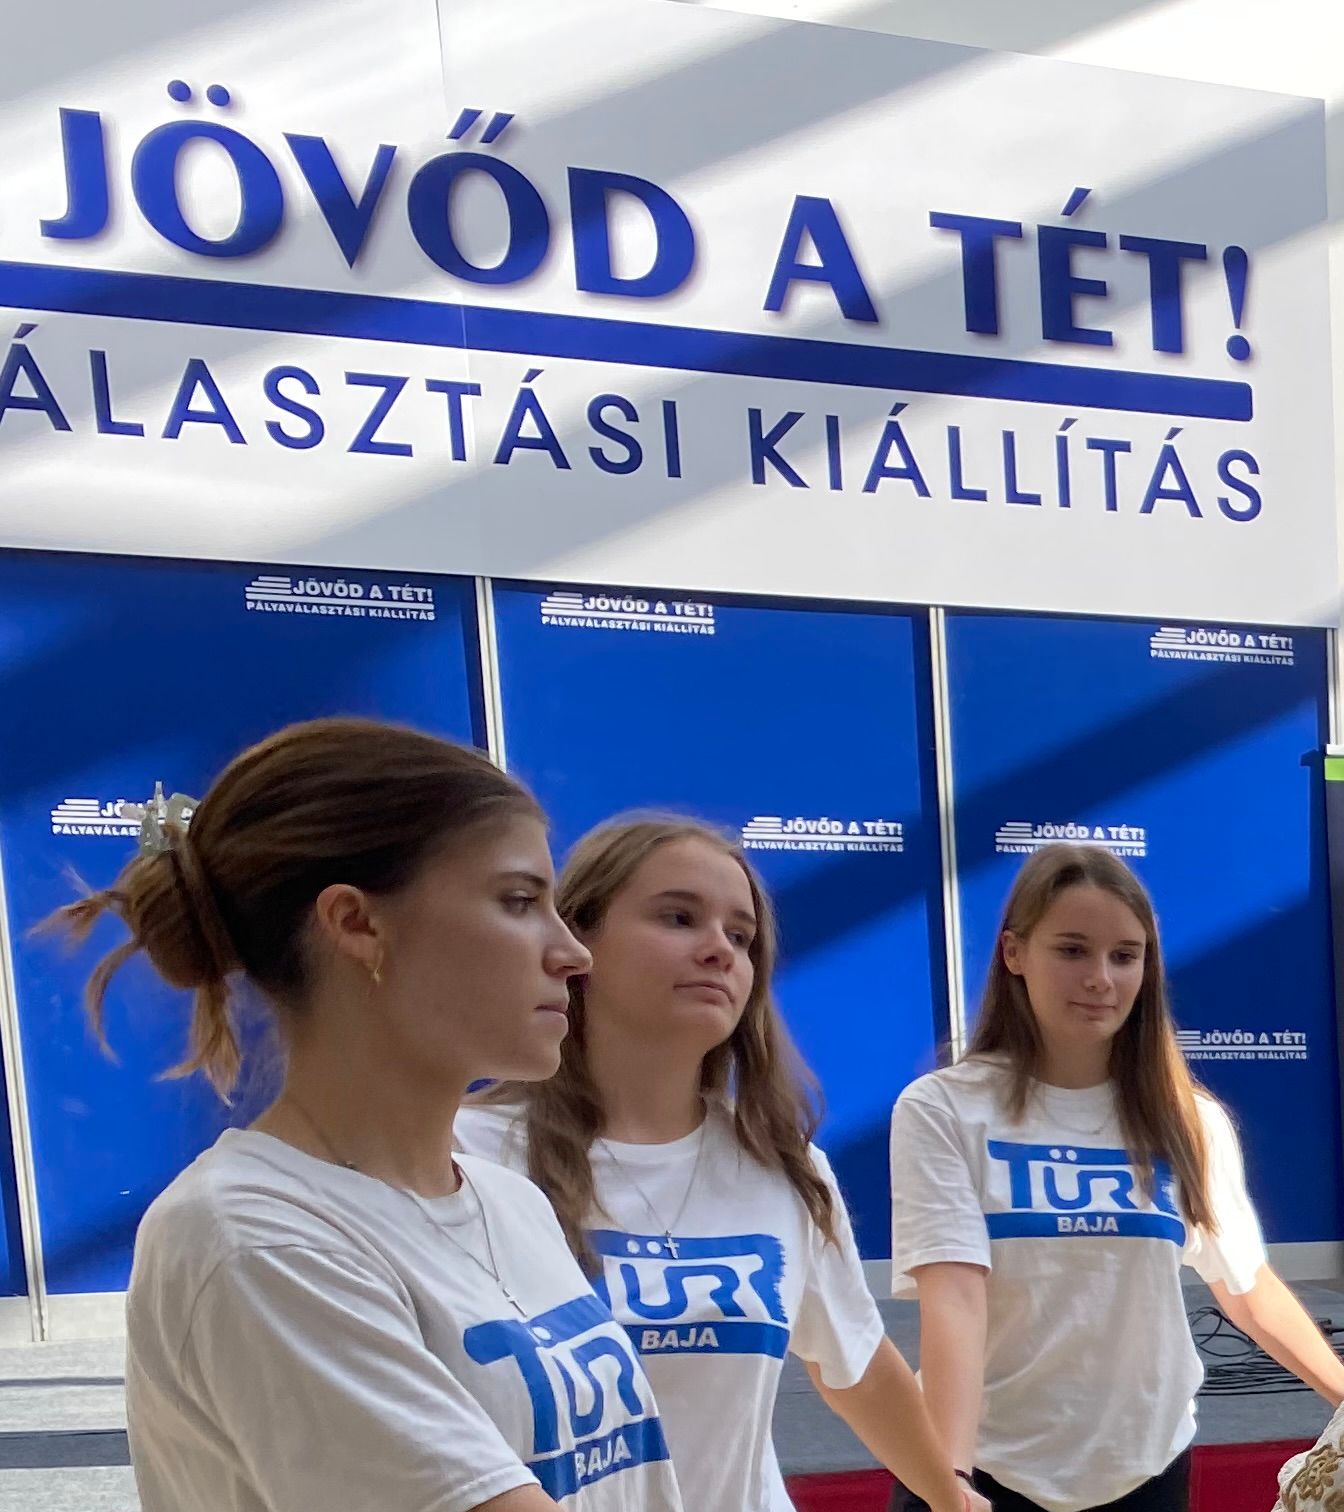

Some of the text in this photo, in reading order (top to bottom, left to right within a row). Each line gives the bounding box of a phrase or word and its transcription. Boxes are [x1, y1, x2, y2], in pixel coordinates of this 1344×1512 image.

[40, 79, 1251, 361] JÖVŐD A TÉT!
[748, 402, 1262, 522] KIÁLLÍTÁS
[369, 585, 383, 599] A
[388, 584, 433, 602] TÉT!
[246, 601, 435, 621] PÁLYAVÁLASZTÁSI KIÁLLÍTÁS
[655, 600, 667, 614] A
[672, 599, 713, 617] TÉT!
[542, 616, 715, 635] PÁLYAVÁLASZTÁSI KIÁLLÍTÁS
[1244, 635, 1255, 647] A
[1258, 633, 1293, 649] TÉT!
[847, 821, 860, 835] A
[863, 819, 902, 835] TÉT!
[1093, 826, 1104, 839] A
[1107, 824, 1145, 840] TÉT!
[1259, 1032, 1269, 1044] A
[1272, 1029, 1306, 1044] TÉT!
[1057, 1216, 1119, 1233] BAJA
[641, 1327, 719, 1350] BAJA
[574, 1434, 632, 1480] BAJA
